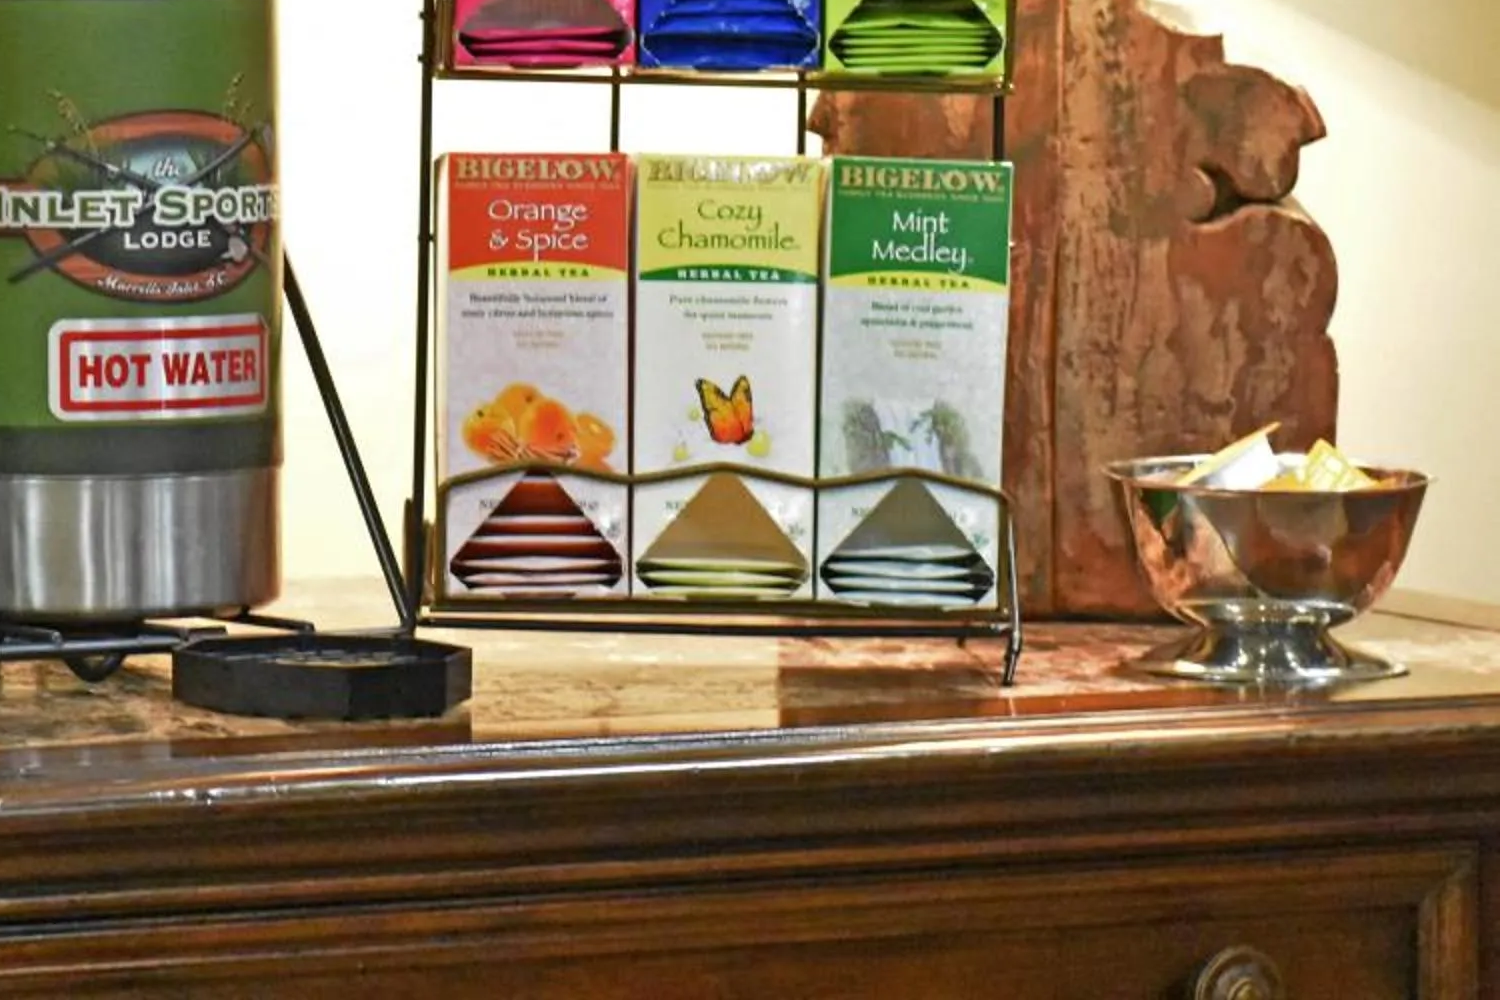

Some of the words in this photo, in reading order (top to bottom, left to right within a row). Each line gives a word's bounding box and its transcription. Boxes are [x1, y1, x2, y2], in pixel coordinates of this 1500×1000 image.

[457, 157, 617, 181] BIGELOW
[840, 164, 1000, 193] BIGELOW
[488, 199, 589, 231] Orange
[697, 198, 763, 231] Cozy
[893, 206, 950, 234] Mint
[124, 230, 211, 250] LODGE
[488, 229, 509, 250] &
[515, 229, 589, 263] Spice
[657, 219, 796, 250] Chamomile
[871, 231, 968, 273] Medley
[559, 267, 590, 278] TEA
[677, 268, 744, 281] HERBAL
[749, 270, 781, 281] TEA
[940, 279, 971, 289] TEA
[78, 353, 151, 389] HOT
[162, 348, 257, 387] WATER
